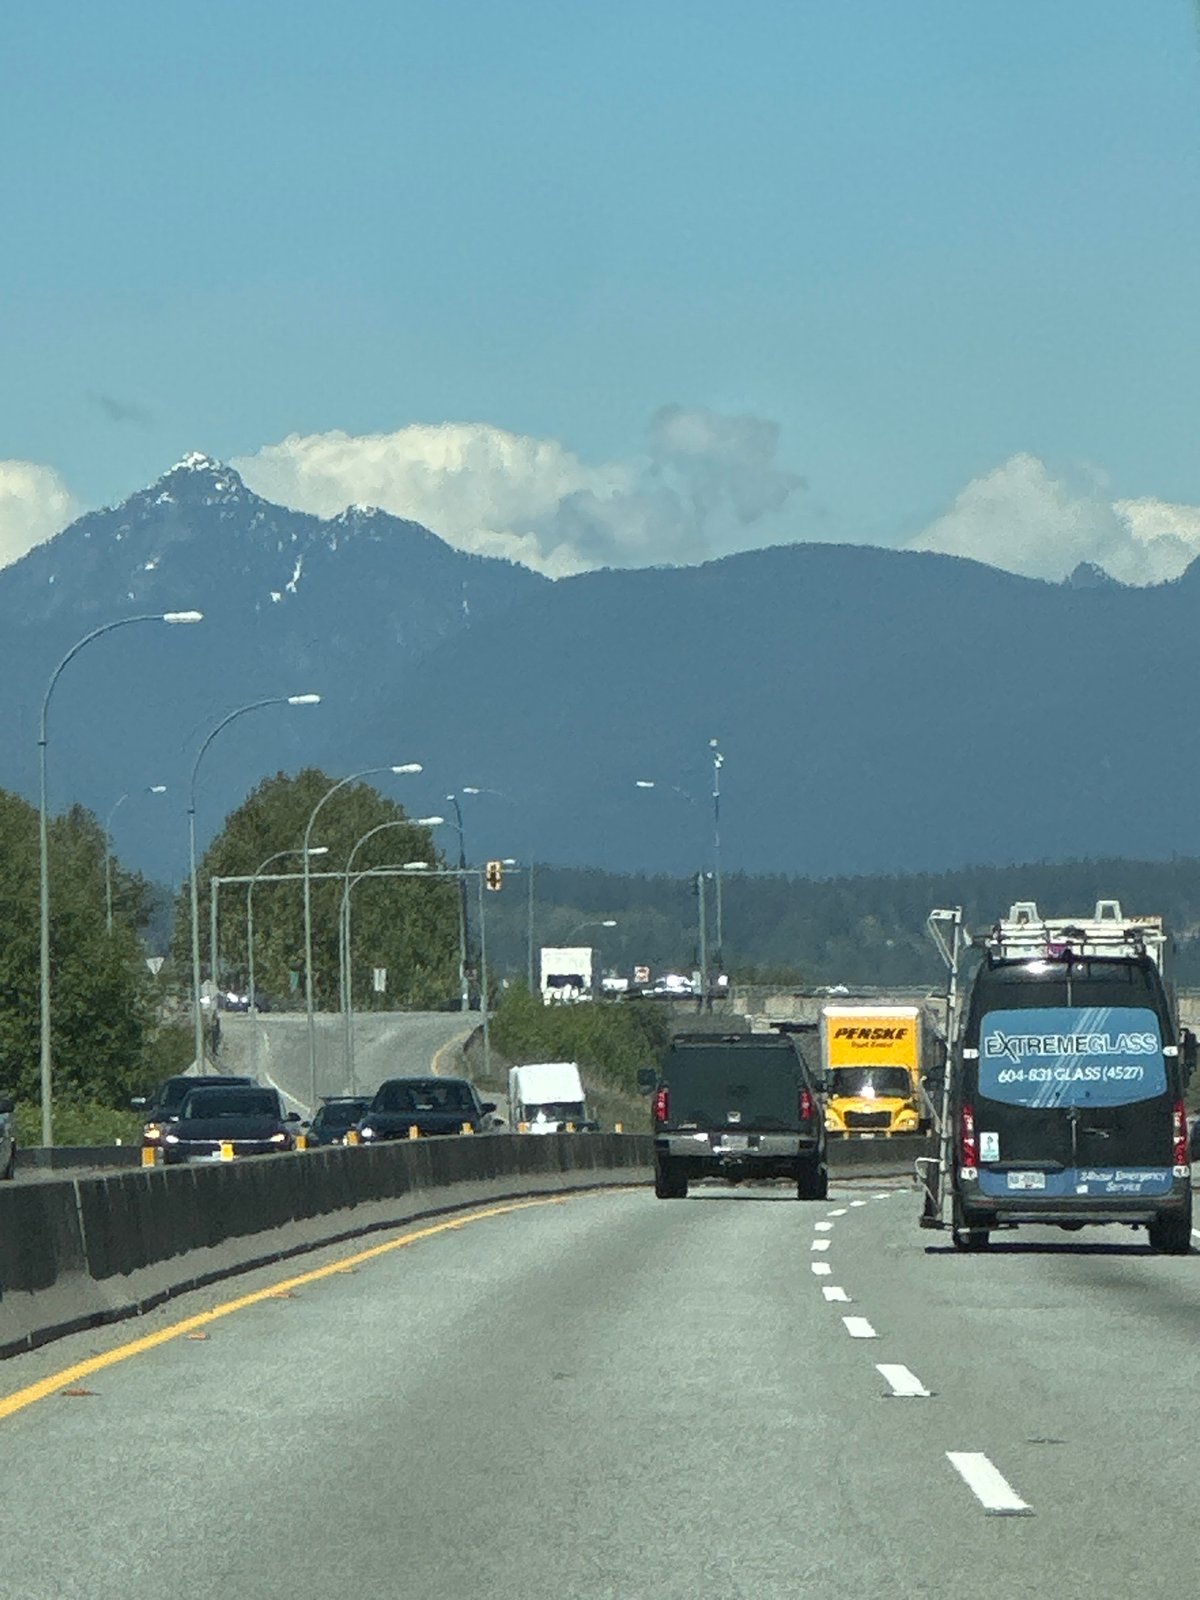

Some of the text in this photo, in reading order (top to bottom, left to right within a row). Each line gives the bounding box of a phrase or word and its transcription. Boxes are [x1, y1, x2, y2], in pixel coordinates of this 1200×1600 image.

[834, 1028, 908, 1040] PENSKE
[985, 1031, 1158, 1064] EXTREMEGLASS
[998, 1066, 1144, 1083] 604-831 GLASS (4527)
